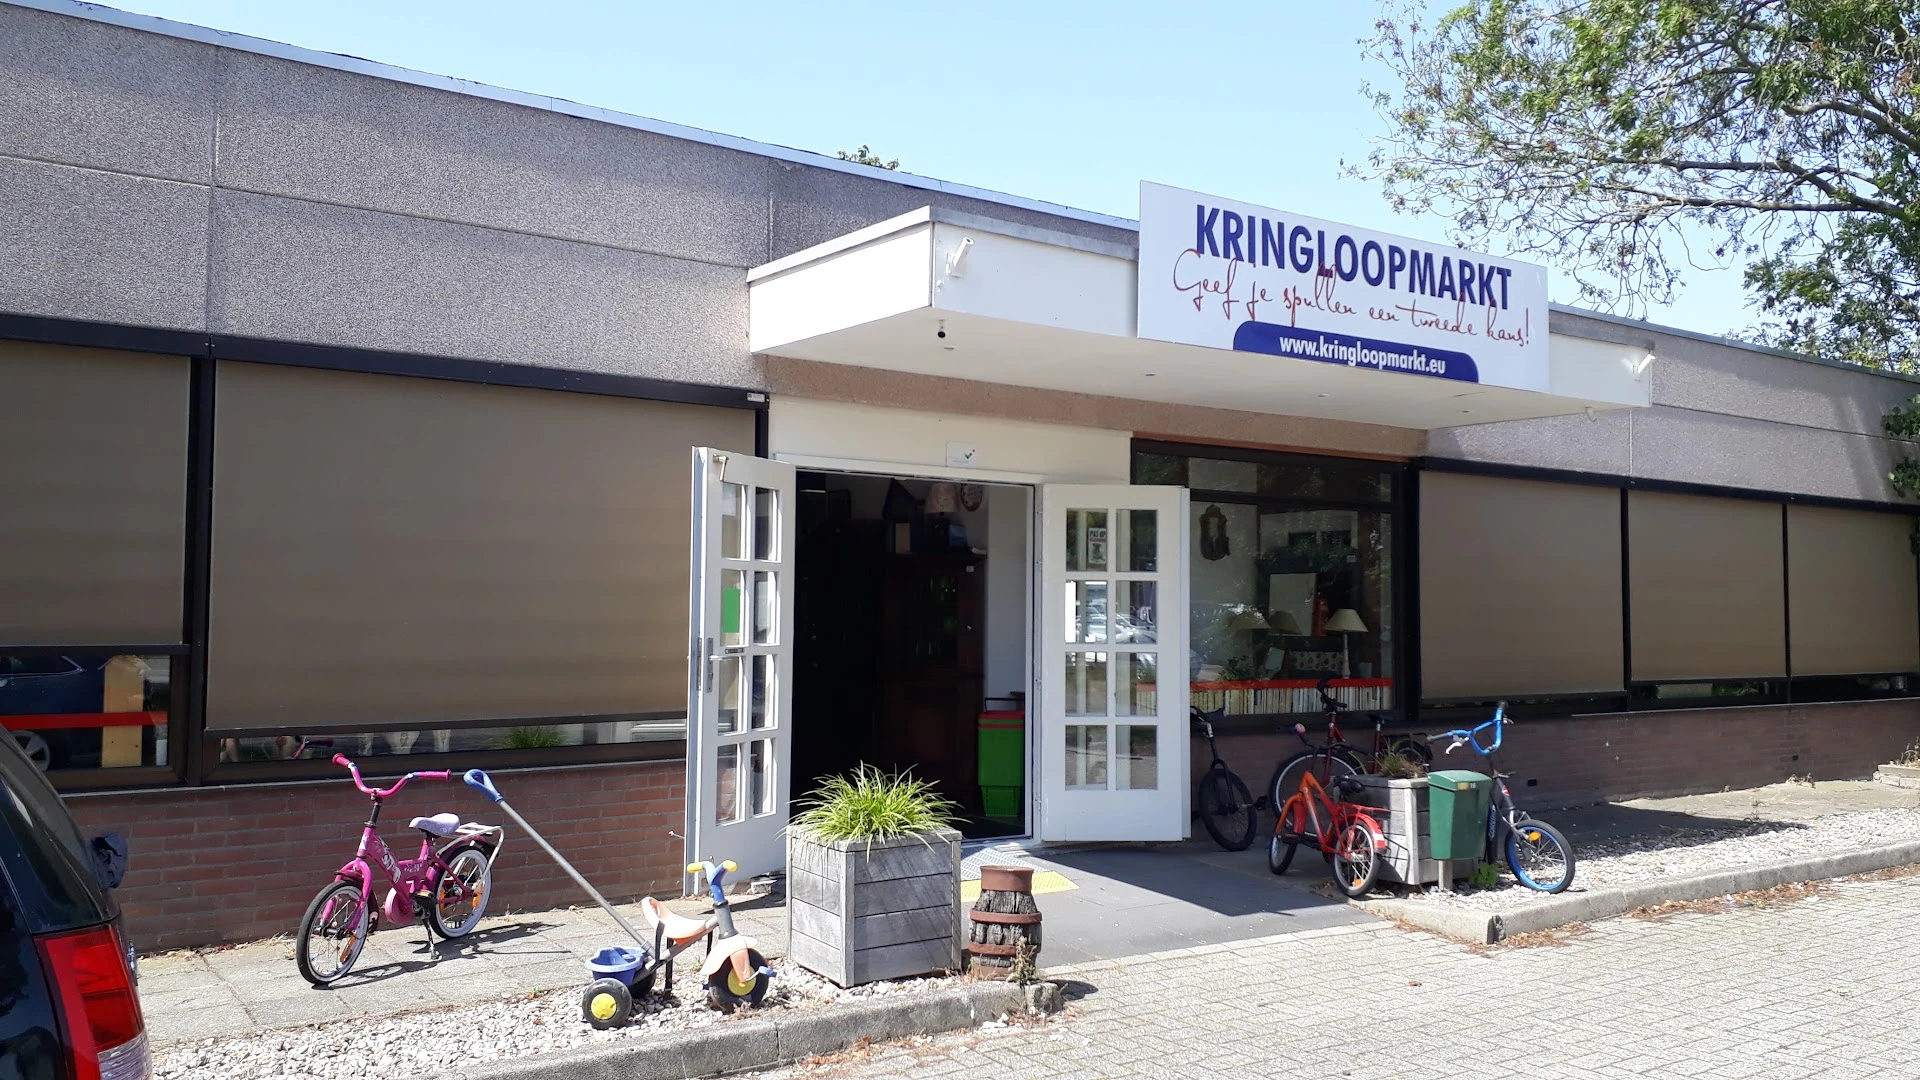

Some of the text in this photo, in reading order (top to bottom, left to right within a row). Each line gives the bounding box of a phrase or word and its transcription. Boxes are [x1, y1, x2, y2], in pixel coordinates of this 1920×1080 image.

[1197, 204, 1512, 309] KRINGLOOPMARKT
[1173, 248, 1529, 347] Geef je spullen een tweede kans!
[1279, 335, 1446, 374] www.kringloopmarkt.eu
[1089, 530, 1099, 538] PAS
